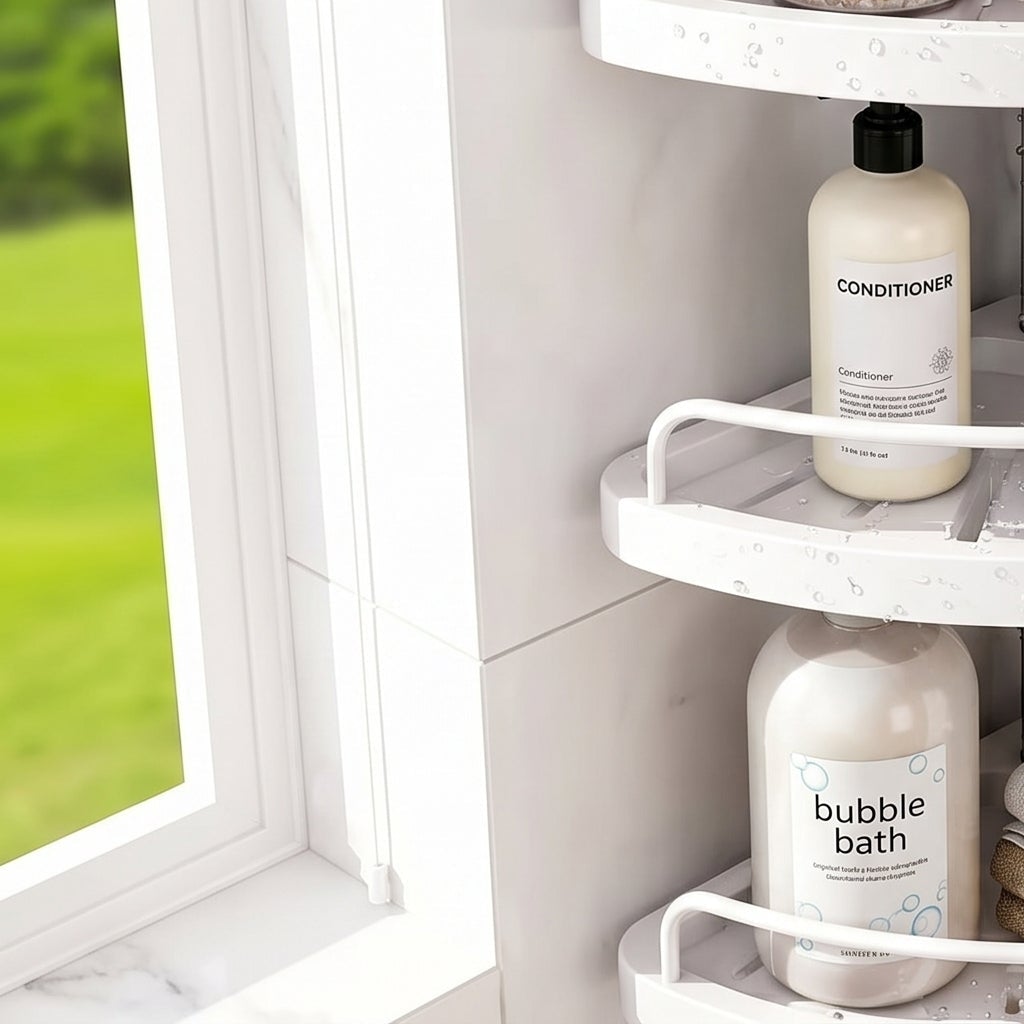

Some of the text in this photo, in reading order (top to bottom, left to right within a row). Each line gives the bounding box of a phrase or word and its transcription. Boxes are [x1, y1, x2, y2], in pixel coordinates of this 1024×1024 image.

[837, 273, 953, 298] CONDITIONER
[838, 366, 893, 381] Conditioner
[815, 793, 925, 824] bubble
[835, 826, 906, 854] bath
